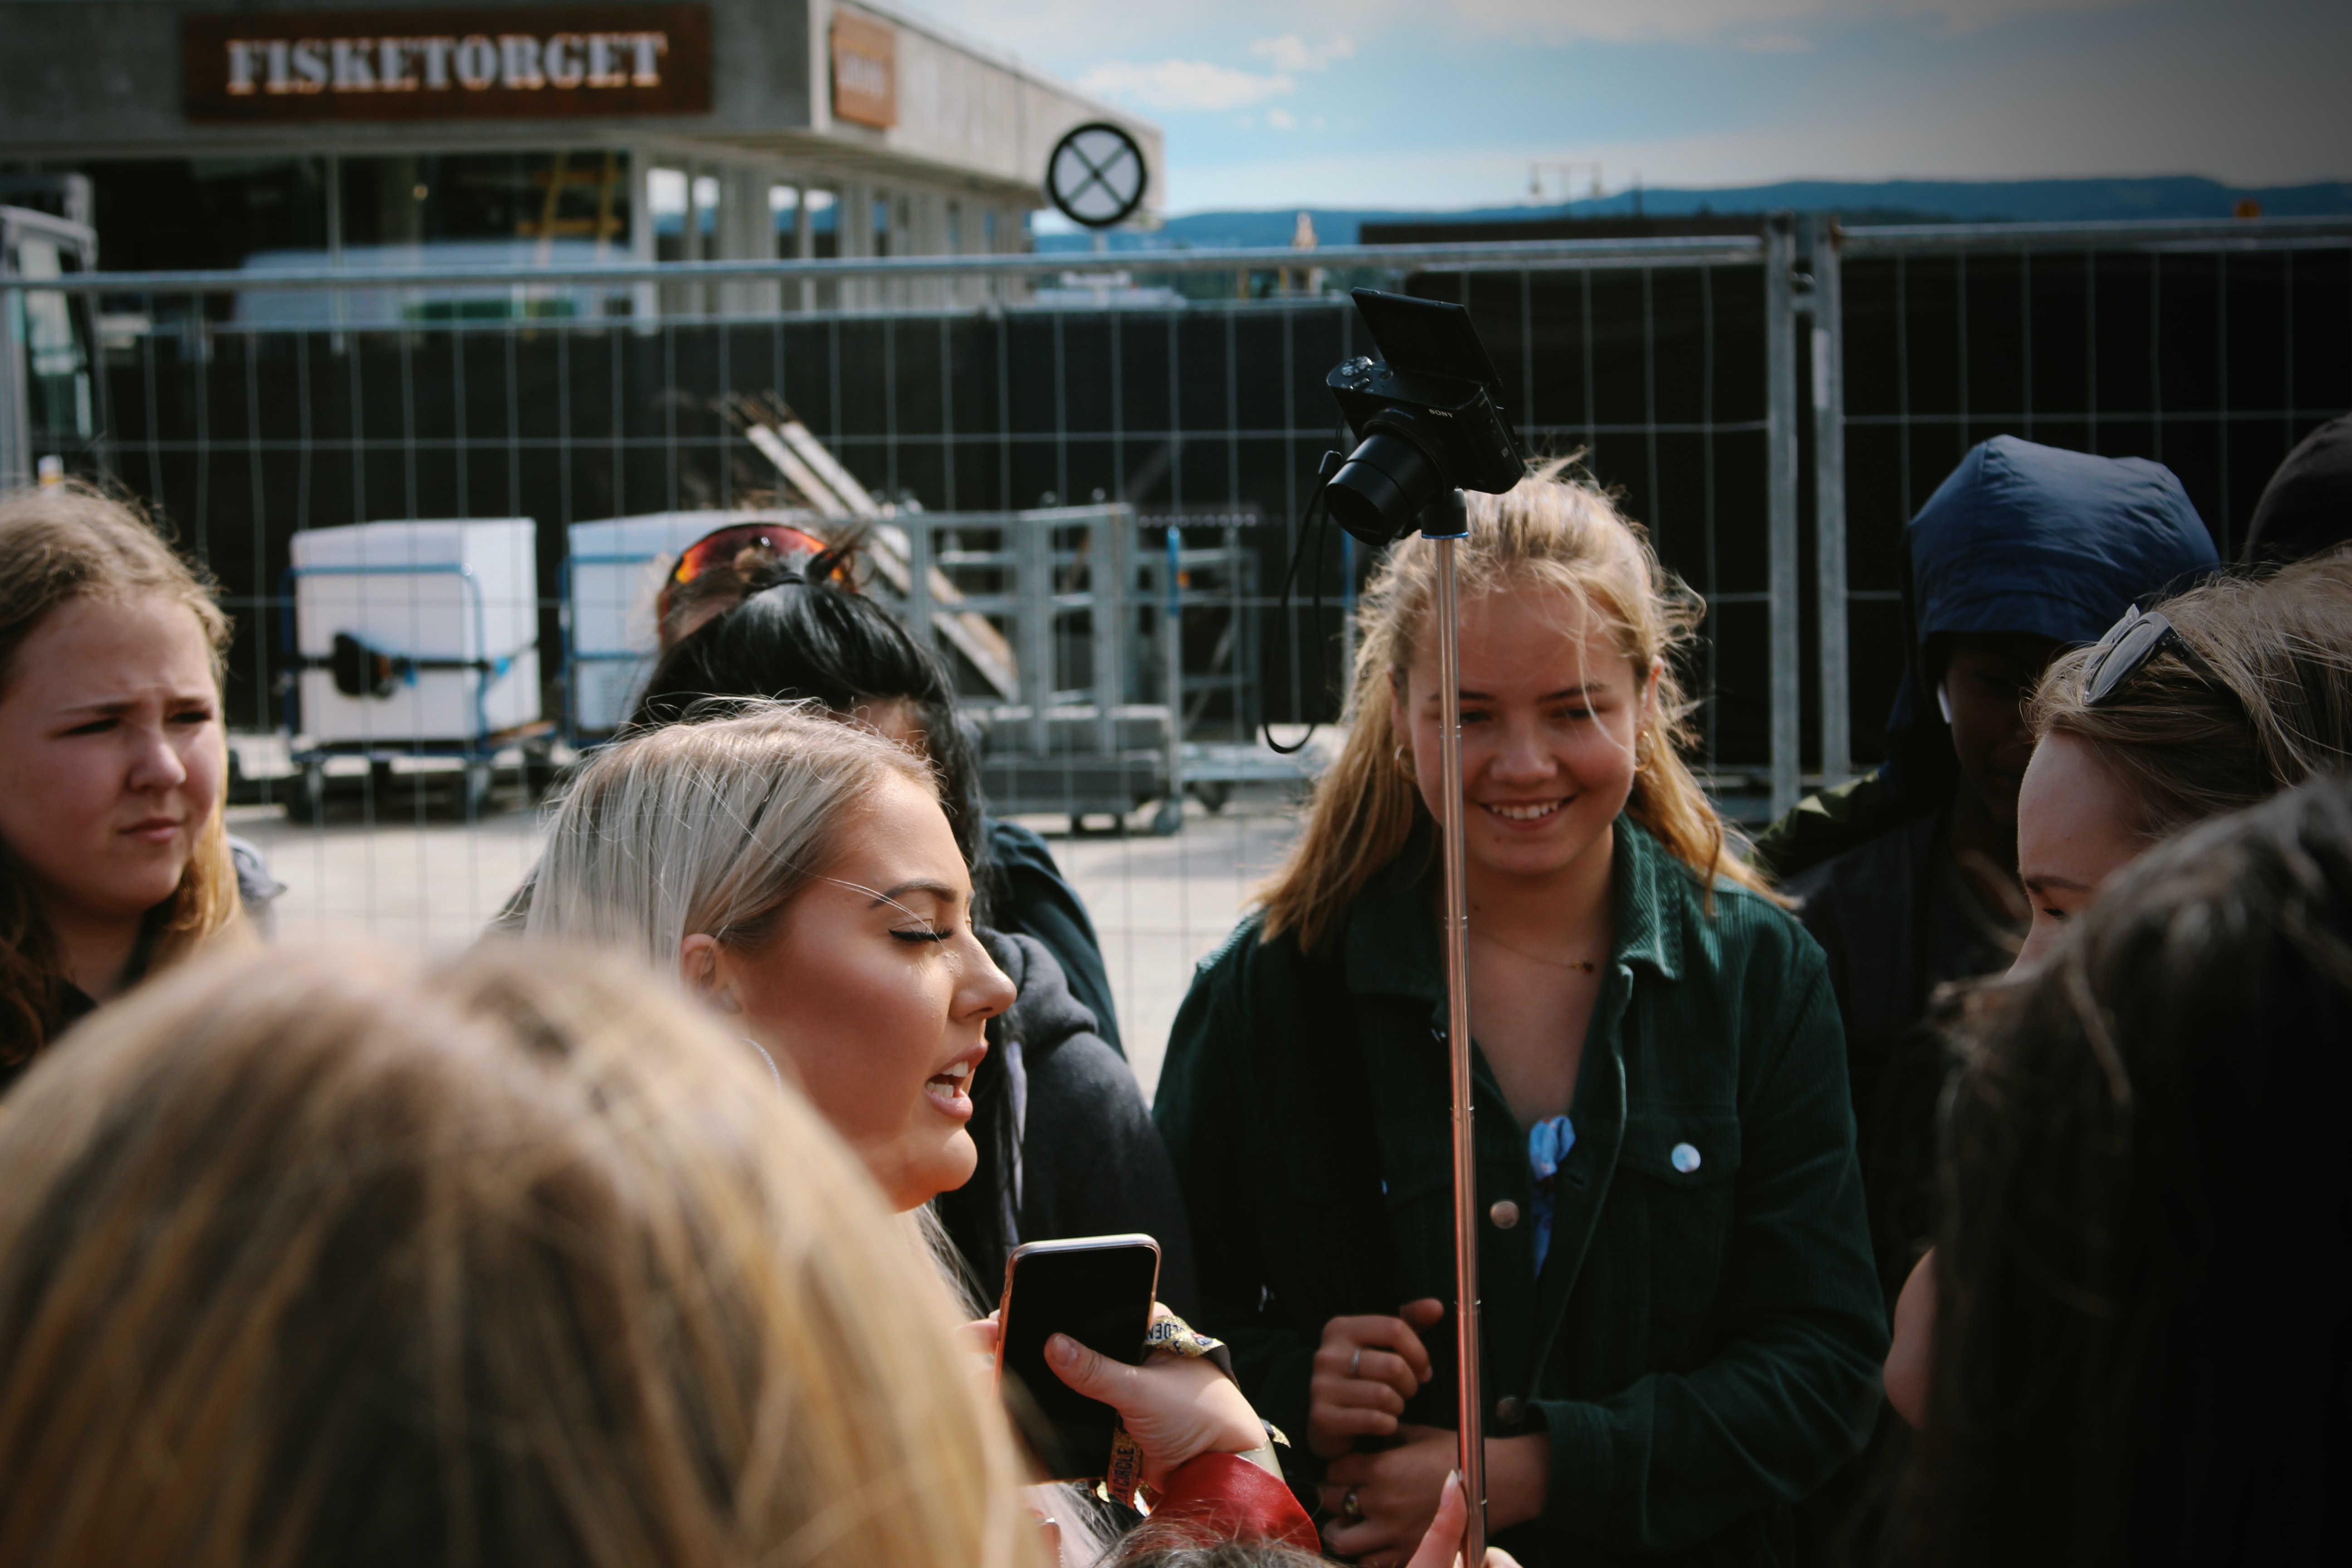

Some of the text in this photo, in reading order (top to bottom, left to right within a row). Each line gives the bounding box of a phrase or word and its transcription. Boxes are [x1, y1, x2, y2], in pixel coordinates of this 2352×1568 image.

[226, 32, 669, 95] FISKETORGET
[1429, 408, 1453, 418] SONY
[1113, 1448, 1134, 1486] CIRCLE
